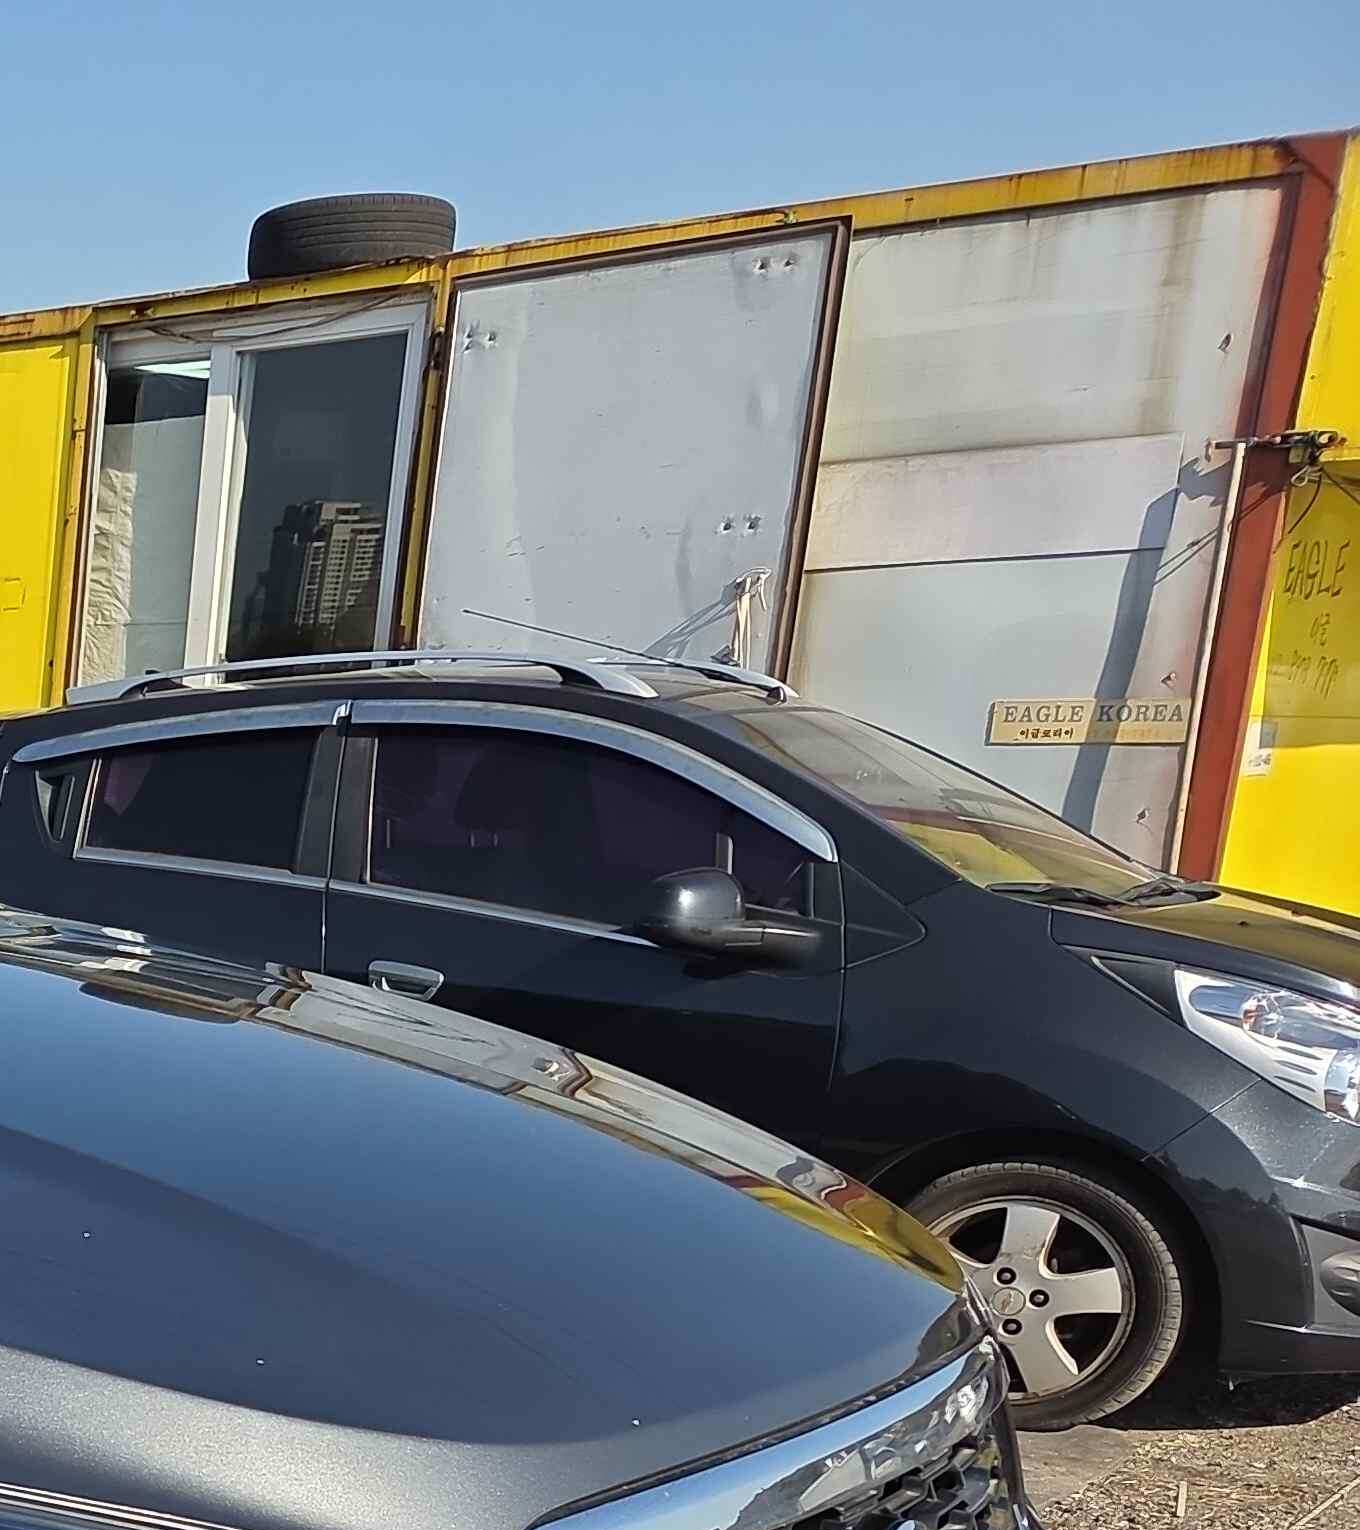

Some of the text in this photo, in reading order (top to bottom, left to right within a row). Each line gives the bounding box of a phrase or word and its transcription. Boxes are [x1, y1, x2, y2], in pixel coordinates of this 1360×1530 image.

[1283, 538, 1351, 600] EAGLE
[1003, 703, 1184, 723] EAGLE KOREA
